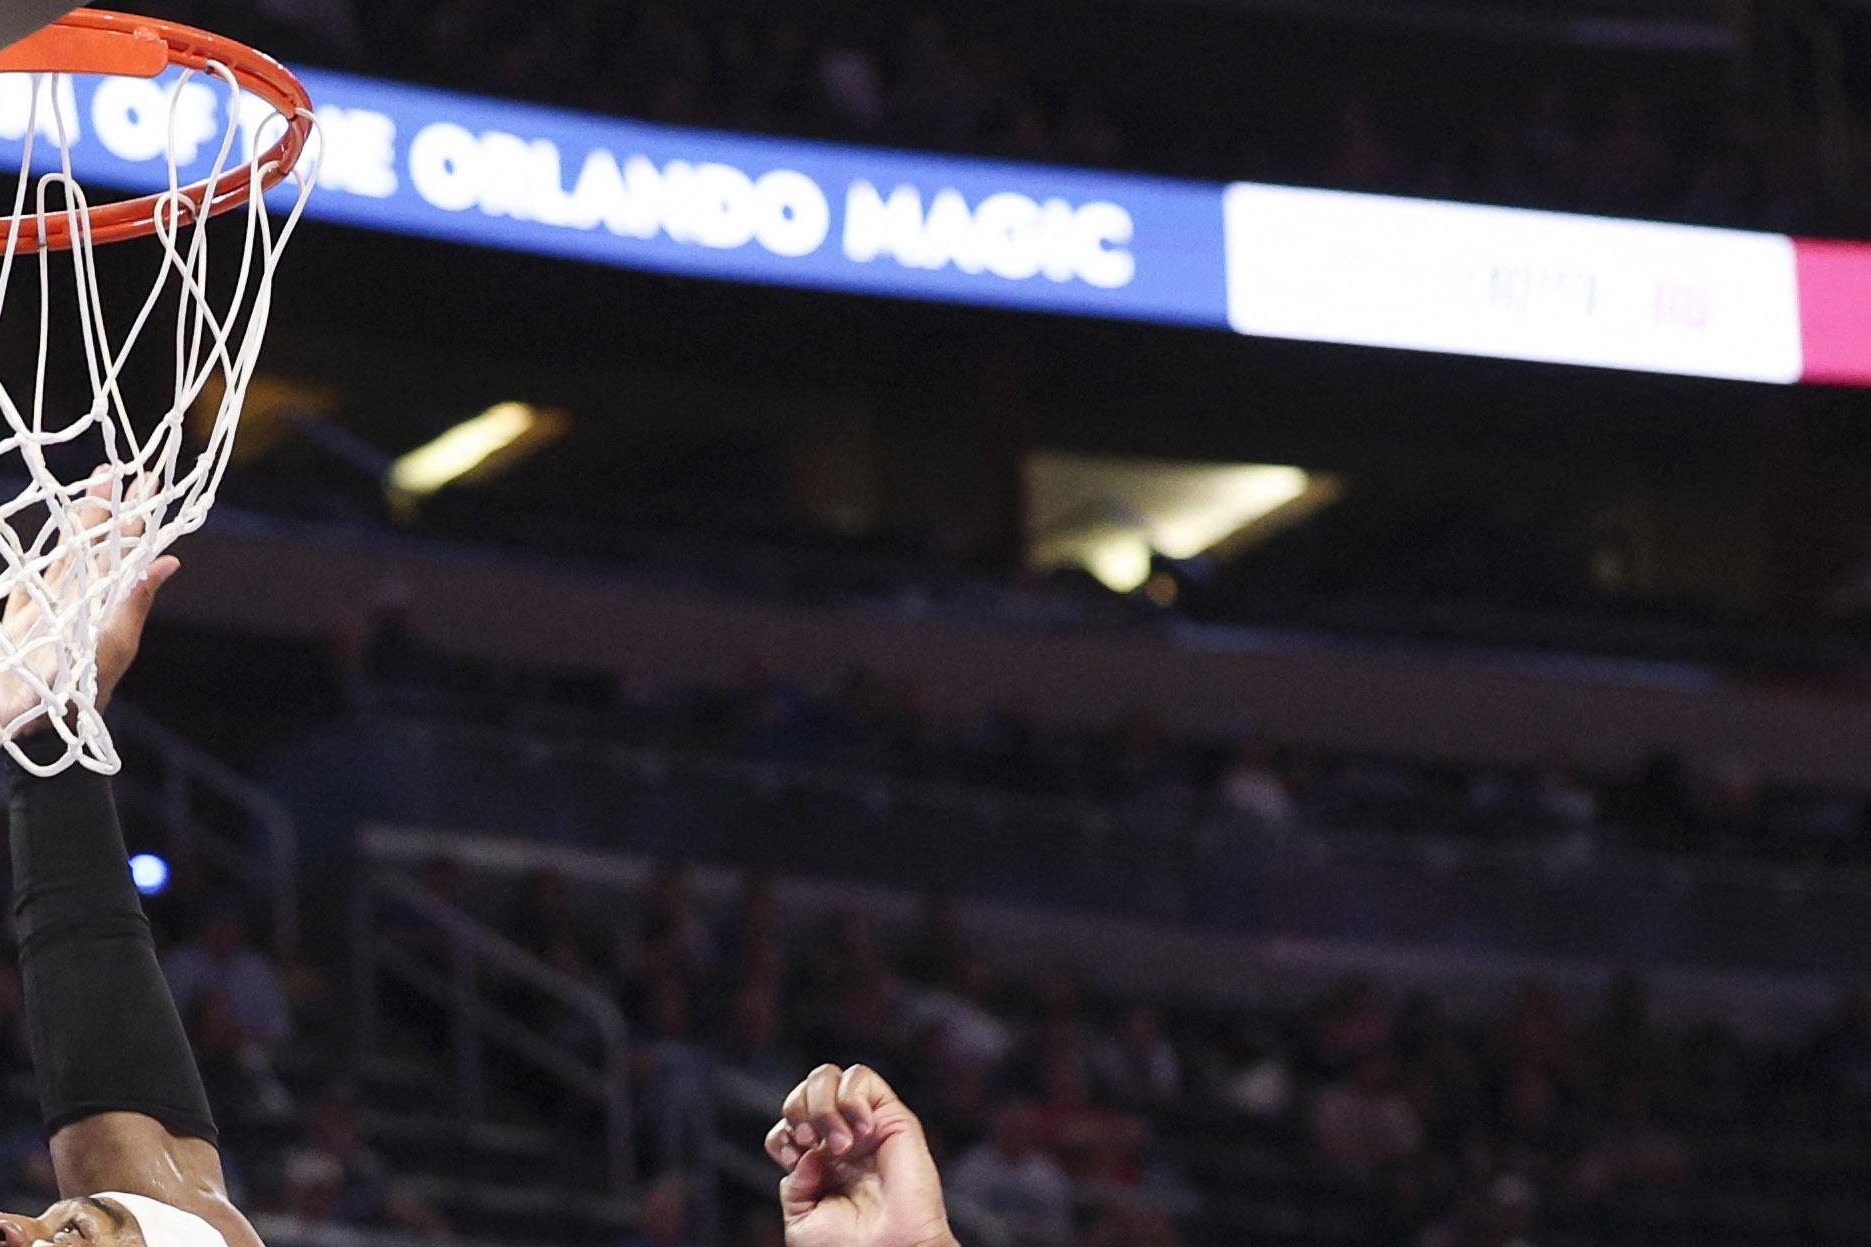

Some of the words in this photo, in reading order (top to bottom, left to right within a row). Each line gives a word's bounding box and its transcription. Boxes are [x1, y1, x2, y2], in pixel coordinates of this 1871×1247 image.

[91, 76, 218, 166] OF
[409, 122, 829, 257] ORLANDO
[843, 178, 1134, 288] MAGIC
